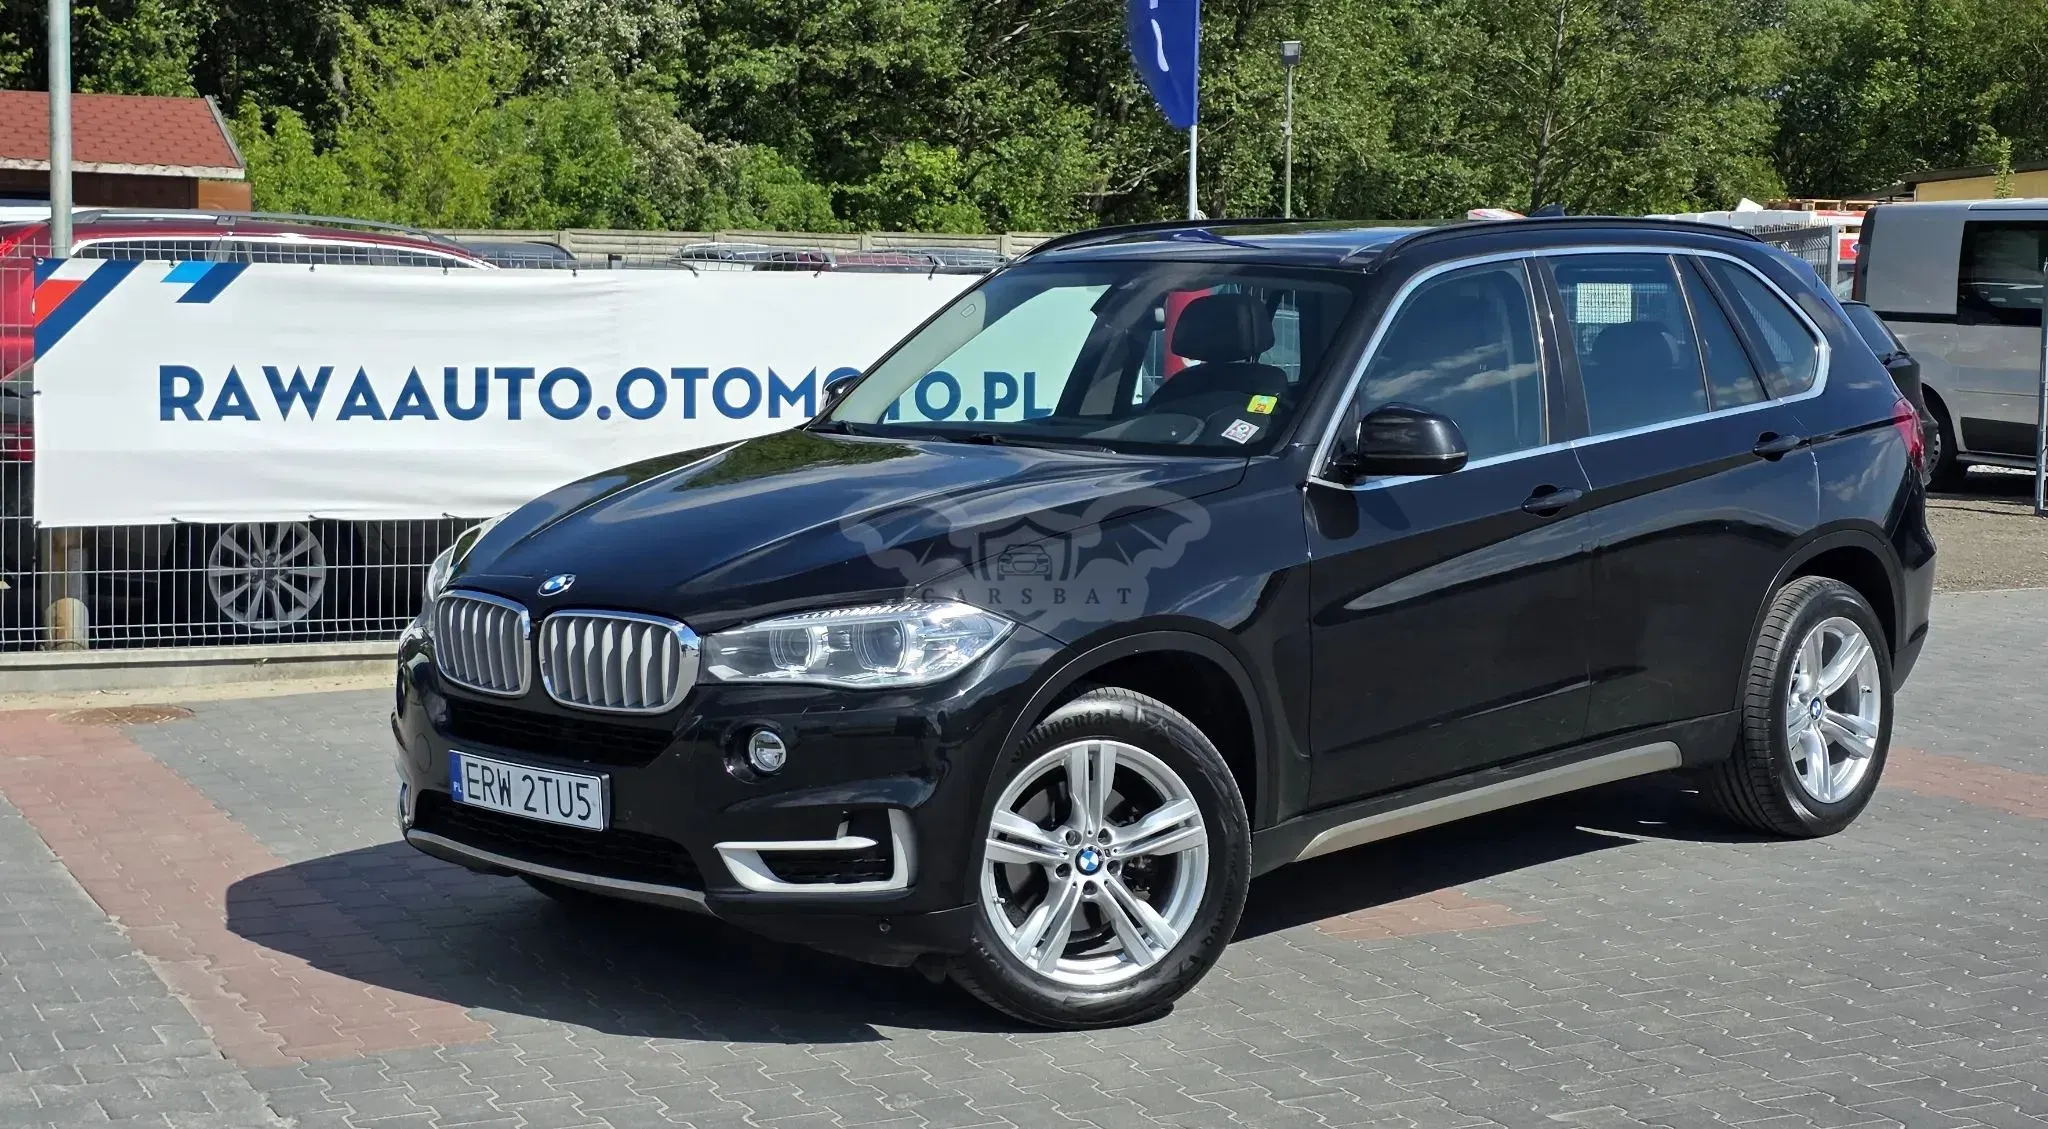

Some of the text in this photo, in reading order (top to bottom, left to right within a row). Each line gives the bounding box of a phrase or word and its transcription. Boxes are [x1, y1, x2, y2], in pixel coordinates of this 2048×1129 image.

[453, 781, 463, 793] PL
[465, 761, 592, 821] ERW 2TU5
